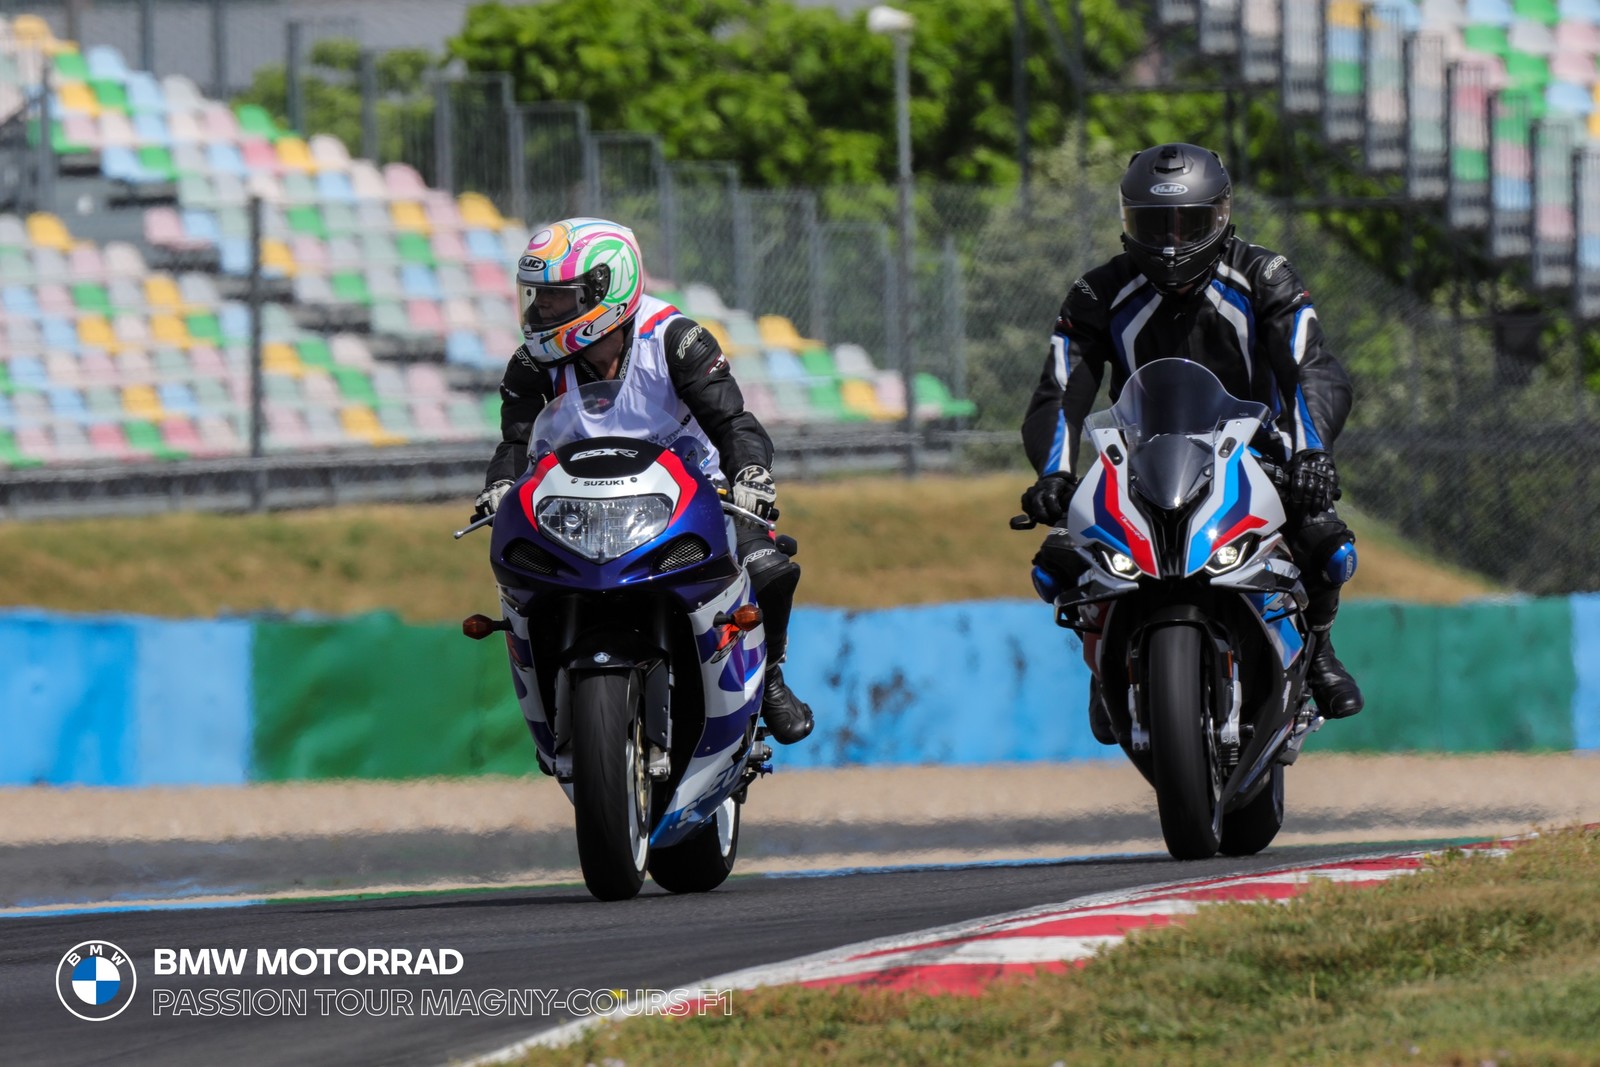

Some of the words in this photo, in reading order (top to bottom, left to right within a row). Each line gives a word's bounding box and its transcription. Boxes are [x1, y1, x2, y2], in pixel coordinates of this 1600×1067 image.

[1154, 184, 1184, 194] HJC
[520, 256, 543, 269] HJC
[675, 324, 703, 360] RST
[514, 346, 540, 373] ST
[742, 548, 776, 569] RST
